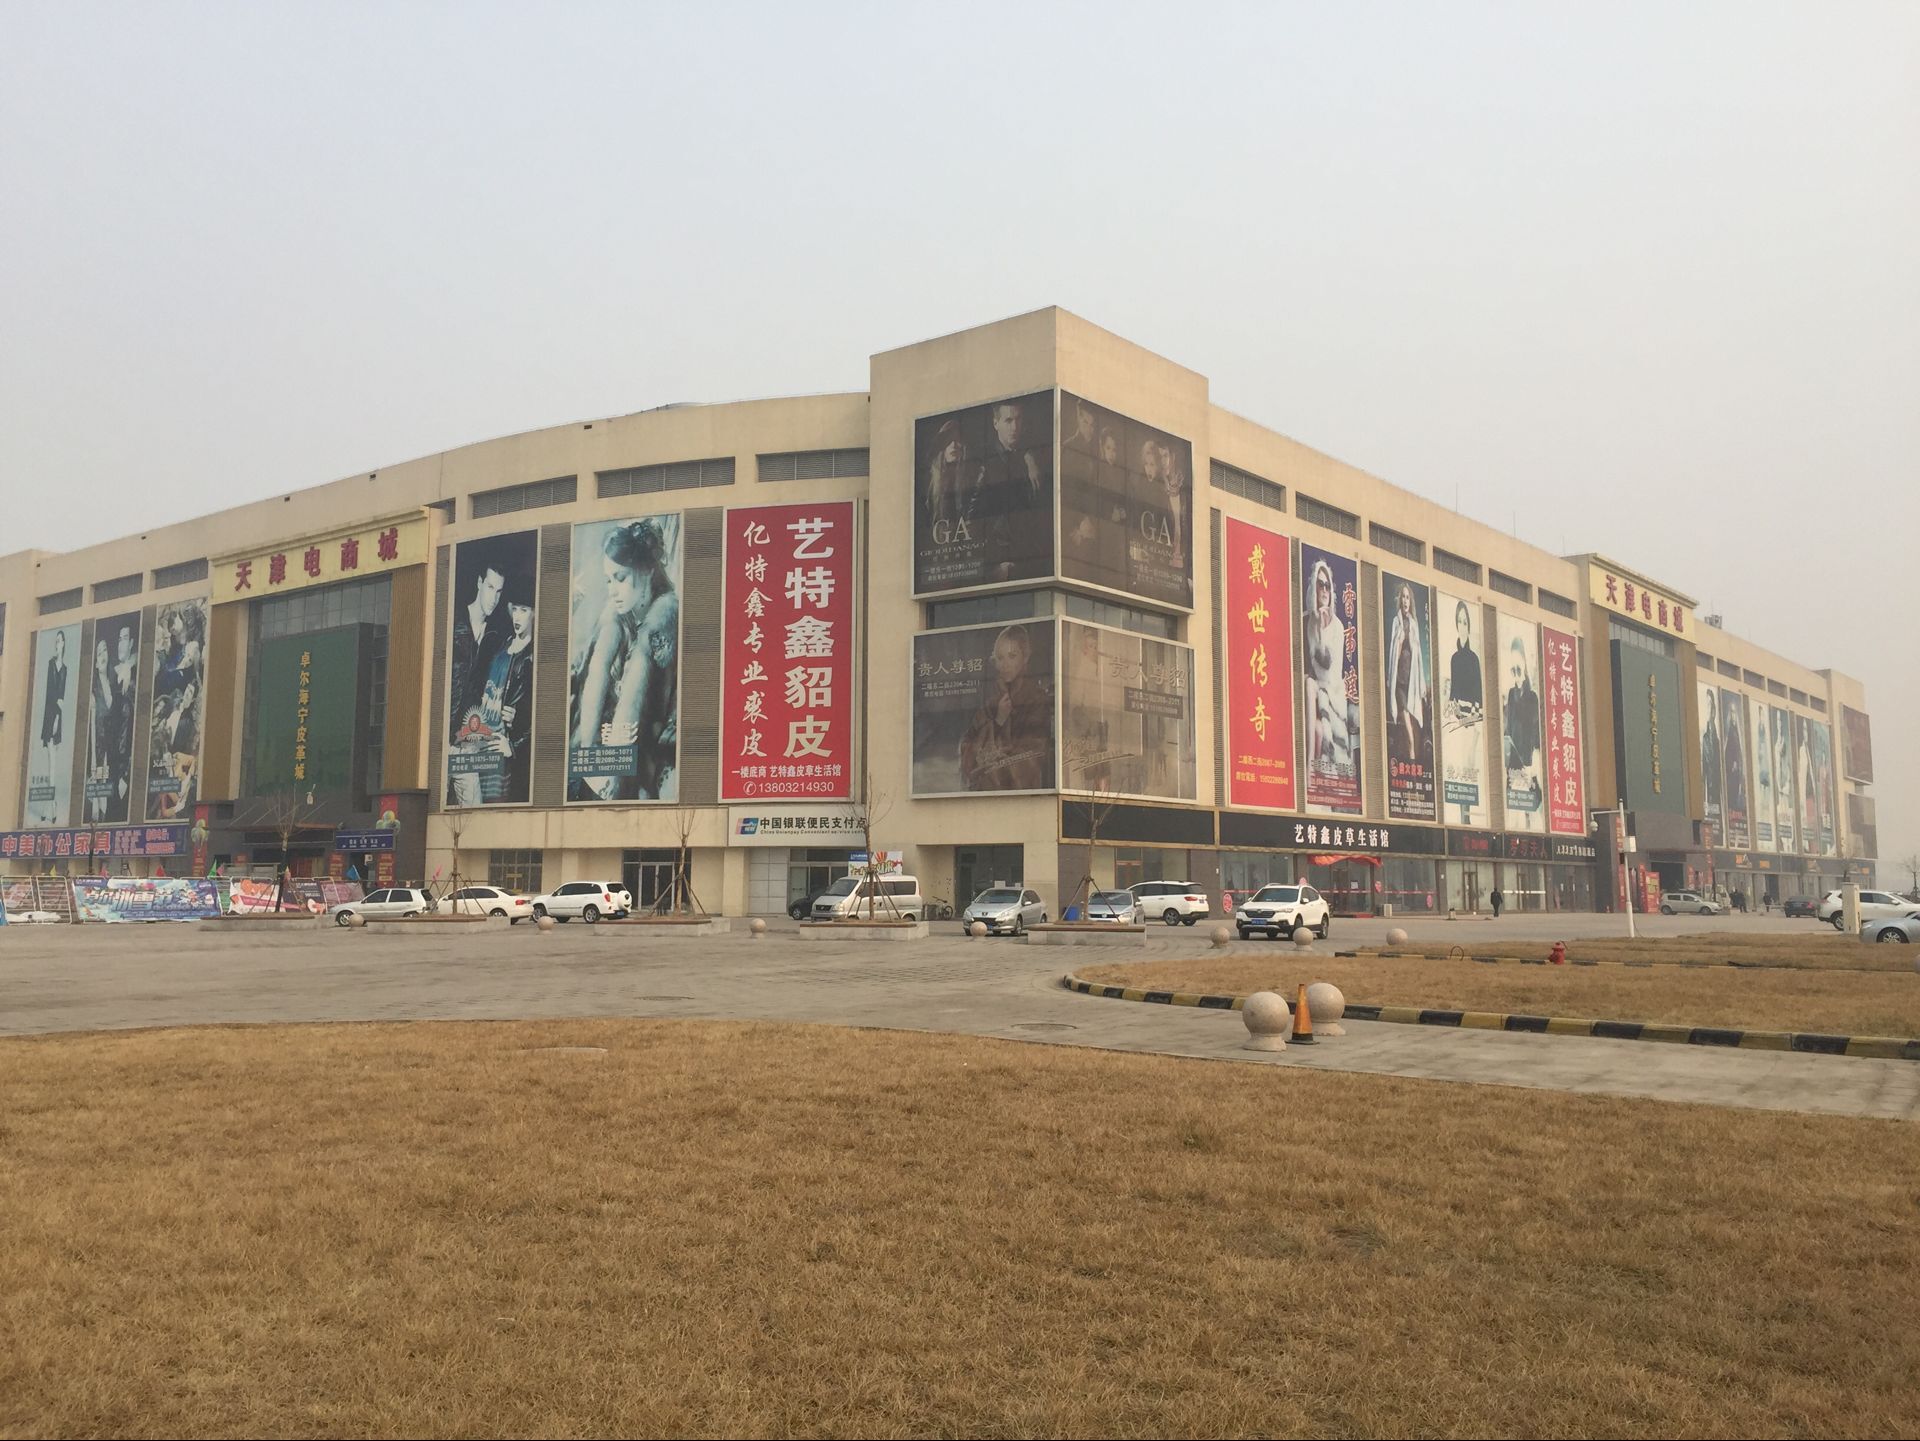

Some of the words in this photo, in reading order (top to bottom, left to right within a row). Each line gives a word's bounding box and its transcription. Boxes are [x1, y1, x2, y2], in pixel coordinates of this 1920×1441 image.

[933, 516, 972, 545] GA
[1140, 510, 1173, 547] GA
[234, 527, 399, 592] 天津电商城
[783, 517, 835, 758] 艺特鑫貂皮
[1247, 542, 1271, 742] 戴世传奇
[918, 658, 984, 677] 贵人尊貂
[294, 651, 311, 781] 卓尔海宁皮革城
[1559, 642, 1578, 807] 艺特鑫貂皮
[732, 766, 767, 778] 一楼底商
[758, 781, 835, 793] 13803214930
[760, 817, 866, 829] 中国银联便民支付点
[1294, 823, 1389, 848] 艺特鑫皮草生活馆
